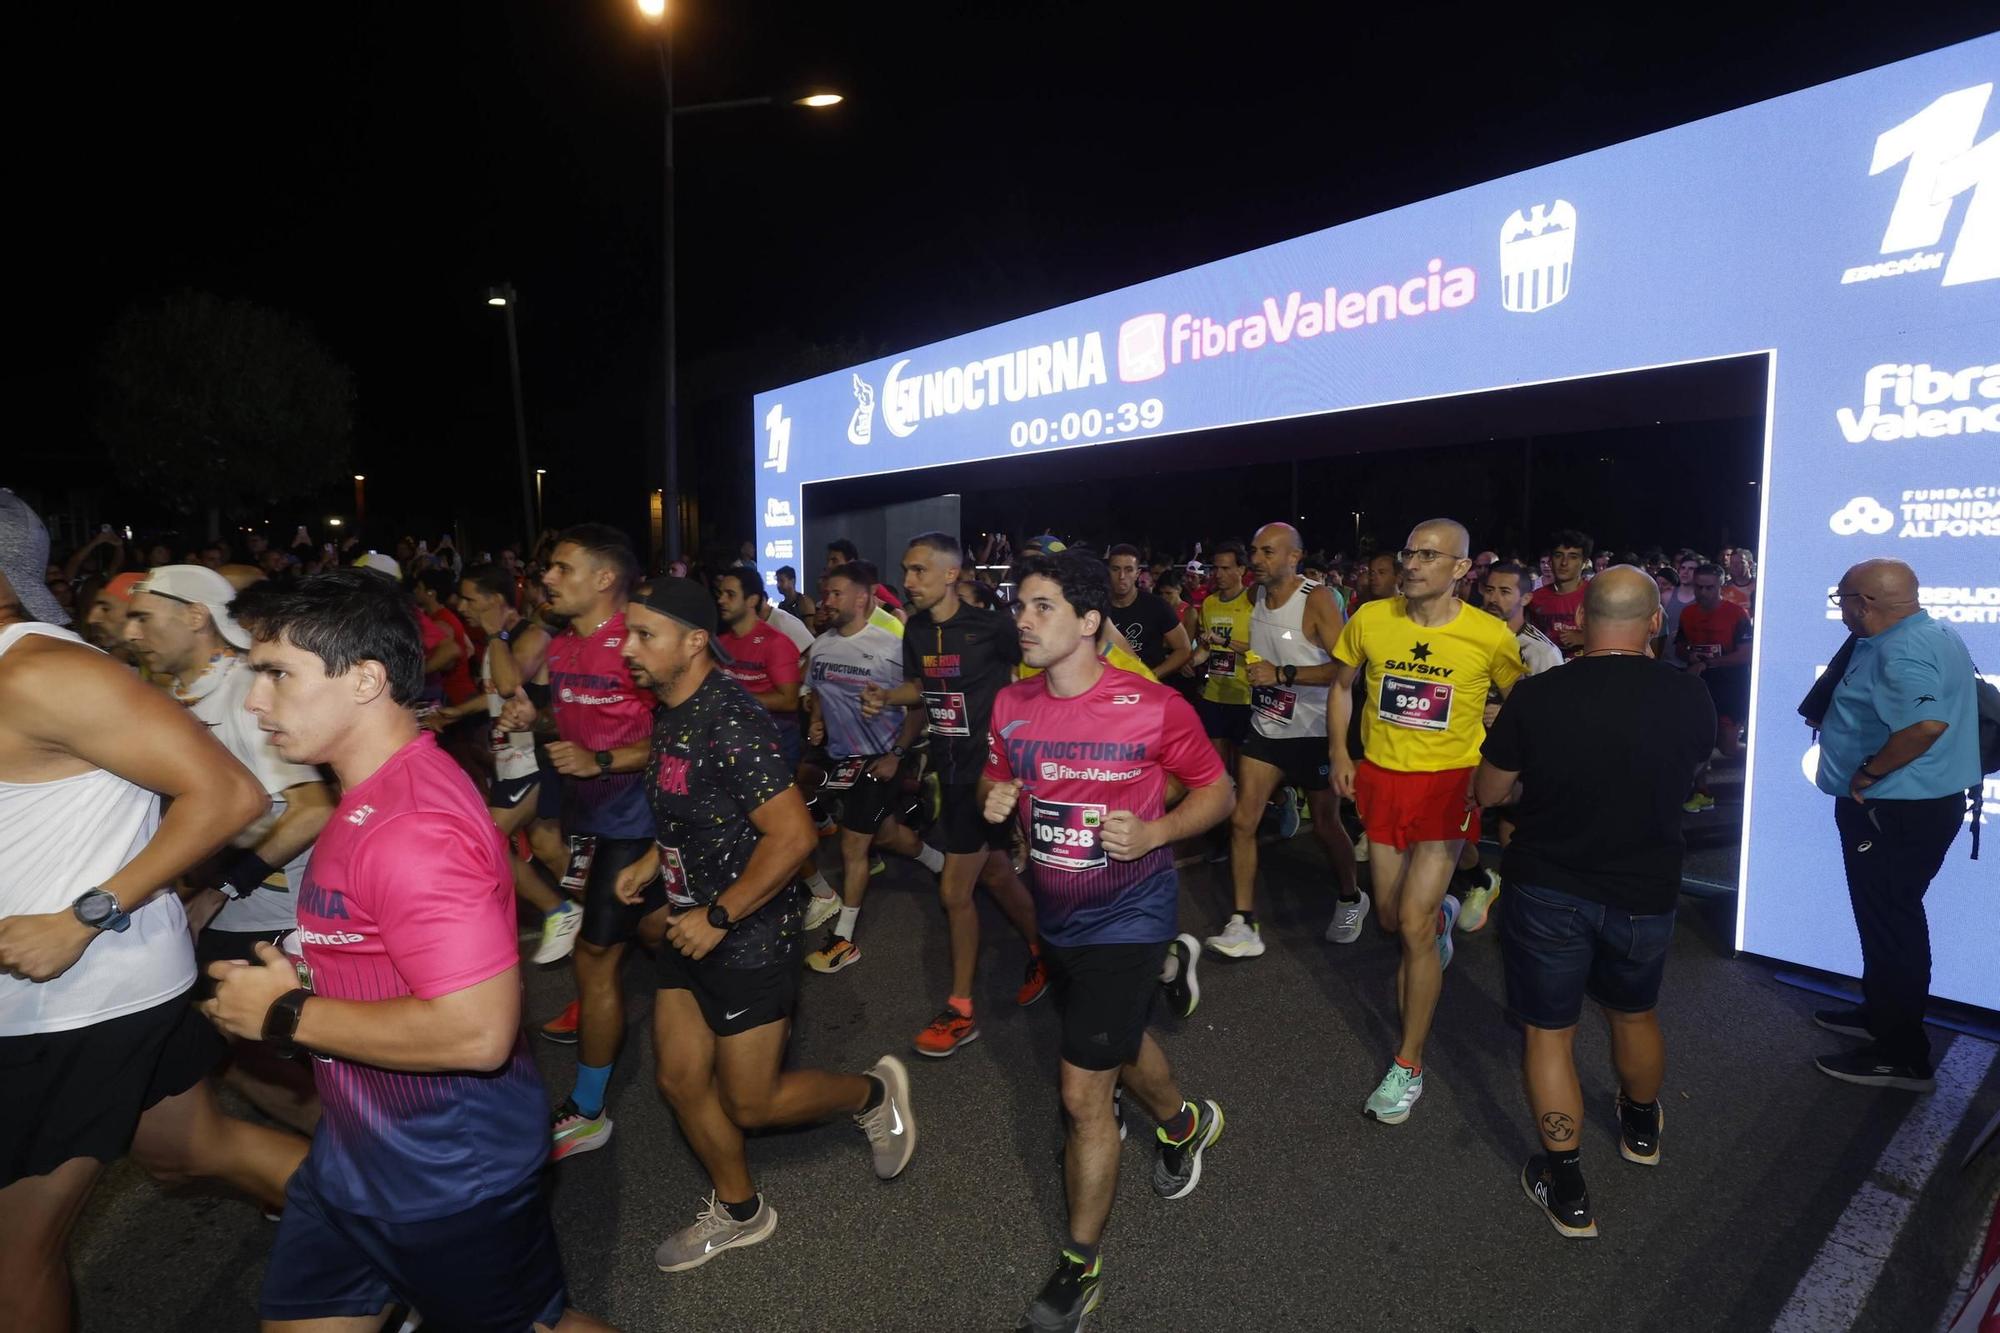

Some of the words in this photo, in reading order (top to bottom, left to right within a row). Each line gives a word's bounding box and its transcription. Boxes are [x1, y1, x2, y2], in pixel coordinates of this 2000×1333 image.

[923, 331, 1108, 419] NOCTURNA
[1009, 398, 1164, 448] 00:00:39
[1902, 486, 2000, 501] FUNDACI
[1384, 659, 1454, 678] SAYSKY
[1396, 694, 1431, 711] 930
[930, 708, 956, 720] 1990
[1040, 741, 1147, 762] NOCTURNA
[1034, 822, 1094, 848] 10528
